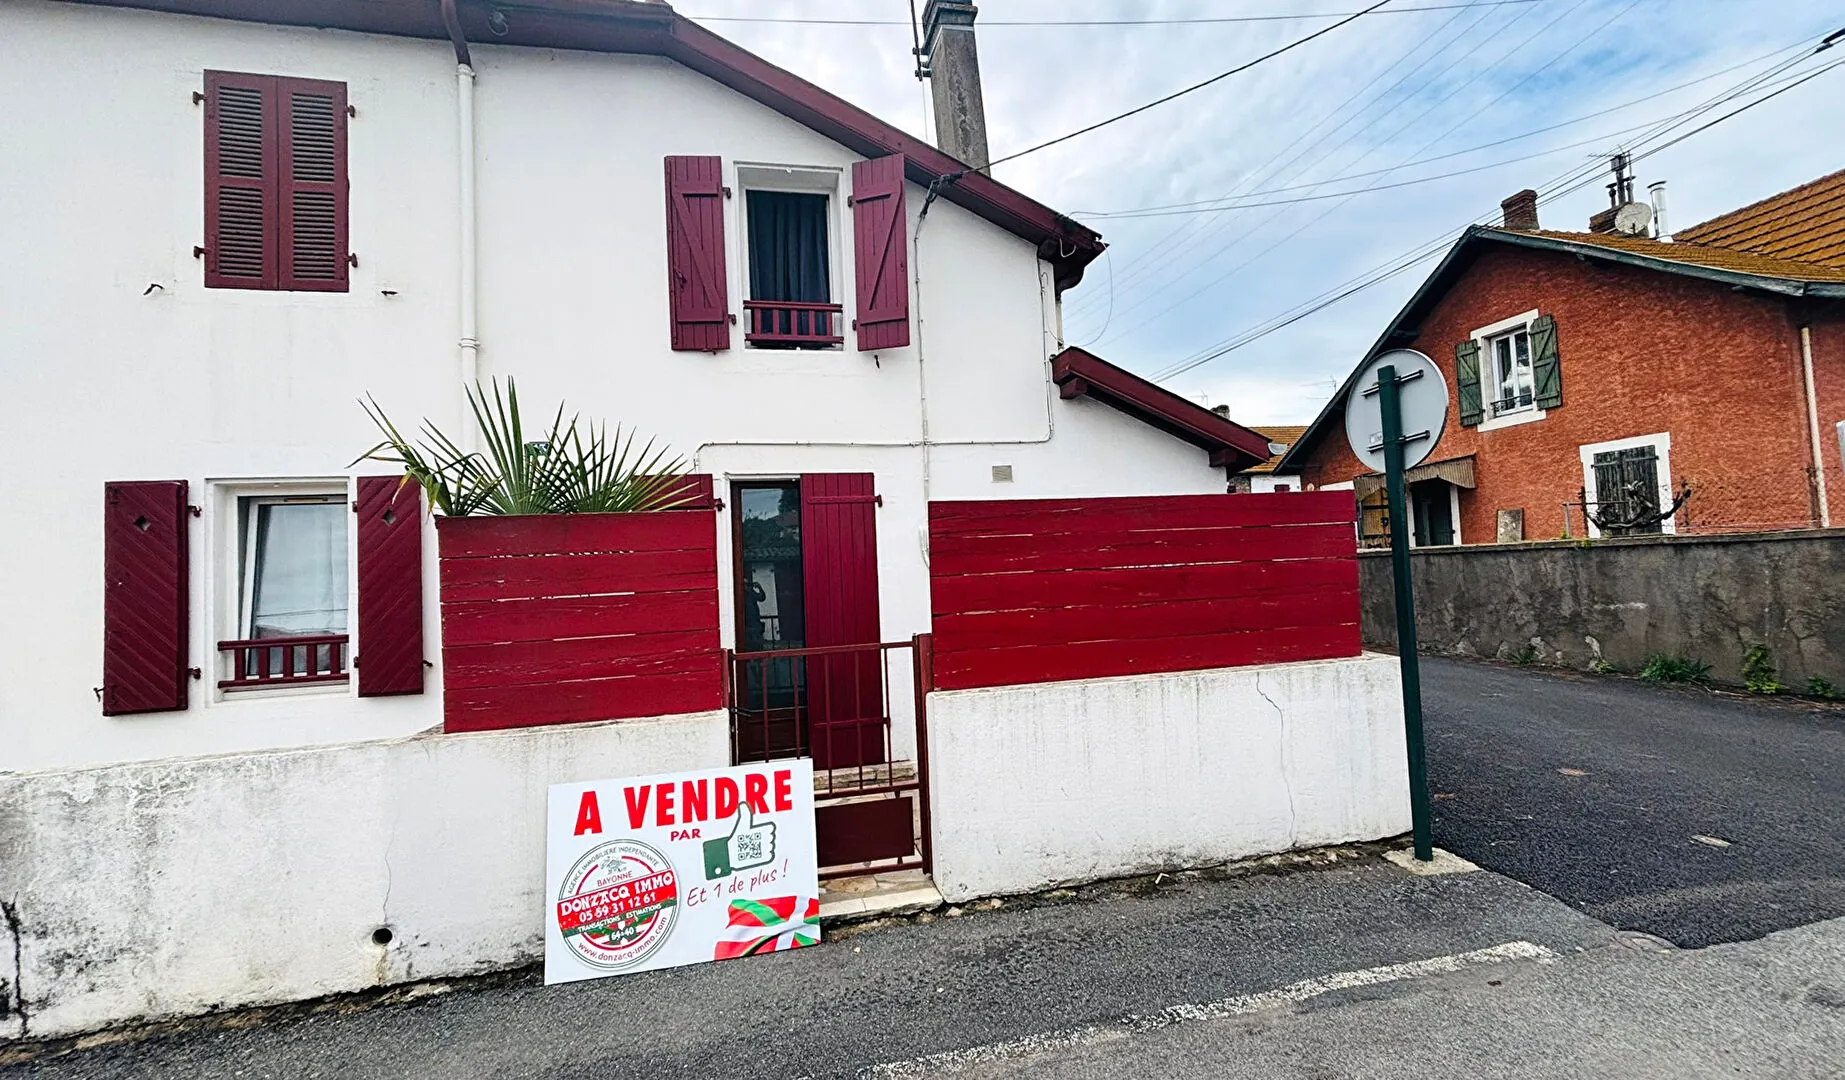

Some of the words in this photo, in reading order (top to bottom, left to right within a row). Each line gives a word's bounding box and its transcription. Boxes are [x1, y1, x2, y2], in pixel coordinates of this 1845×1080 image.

[574, 791, 602, 836] A
[623, 769, 793, 830] VENDRE
[670, 828, 702, 842] PAR
[568, 869, 583, 894] AGENCE
[597, 870, 633, 887] BAYONNE
[687, 887, 707, 907] Et
[714, 883, 722, 898] 1
[728, 876, 744, 894] de
[750, 869, 777, 892] plus
[782, 858, 788, 878] !
[560, 887, 631, 917] DONZACQ
[634, 872, 674, 895] IMMO
[579, 911, 593, 923] 05
[611, 901, 625, 914] 31
[628, 896, 641, 908] 12
[643, 892, 656, 904] 61
[577, 914, 621, 933] TRANSACTIONS
[626, 903, 662, 919] ESTIMATIONS
[578, 916, 667, 962] www.donzacq-immo.com
